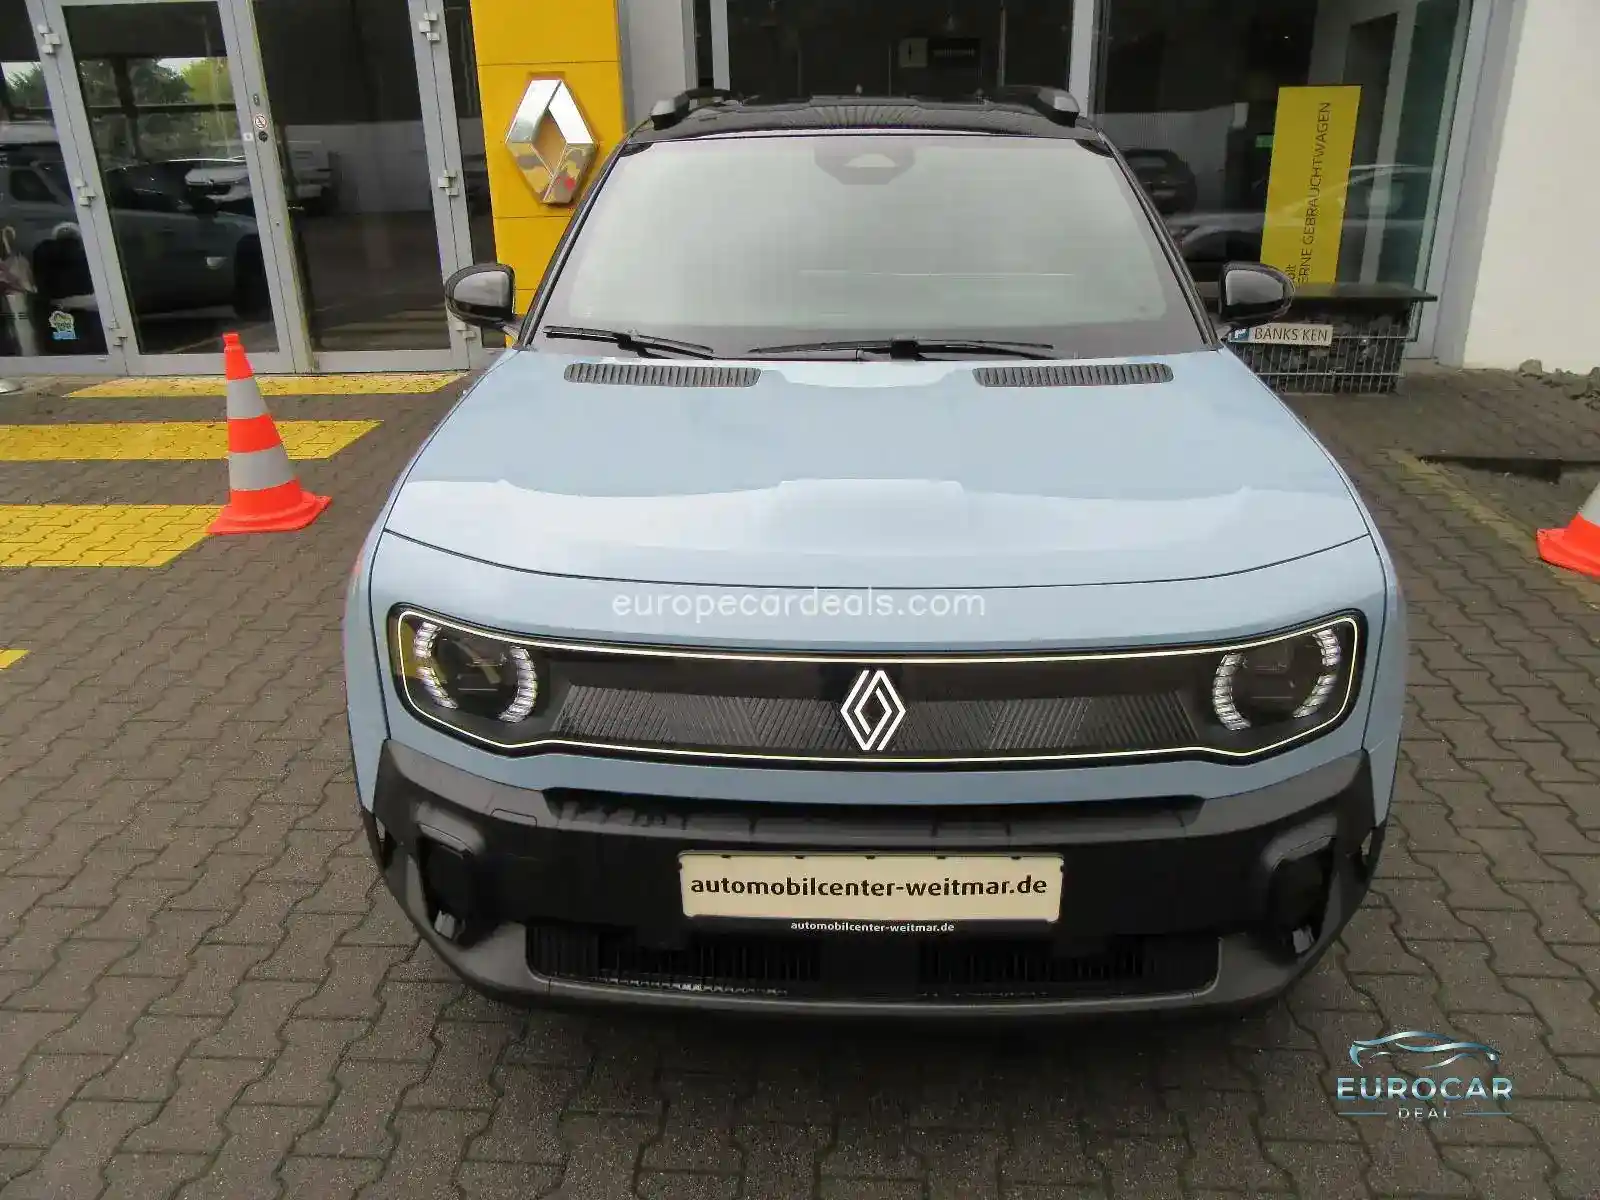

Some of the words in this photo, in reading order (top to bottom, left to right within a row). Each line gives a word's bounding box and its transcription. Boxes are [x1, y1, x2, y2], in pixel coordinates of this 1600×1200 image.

[1302, 102, 1332, 245] GEBRAUCHTWAGEN
[1302, 328, 1328, 342] KEN
[690, 874, 1048, 897] automobilcenter-weitmar.de
[790, 920, 955, 933] automobilcenter-weitmar.de
